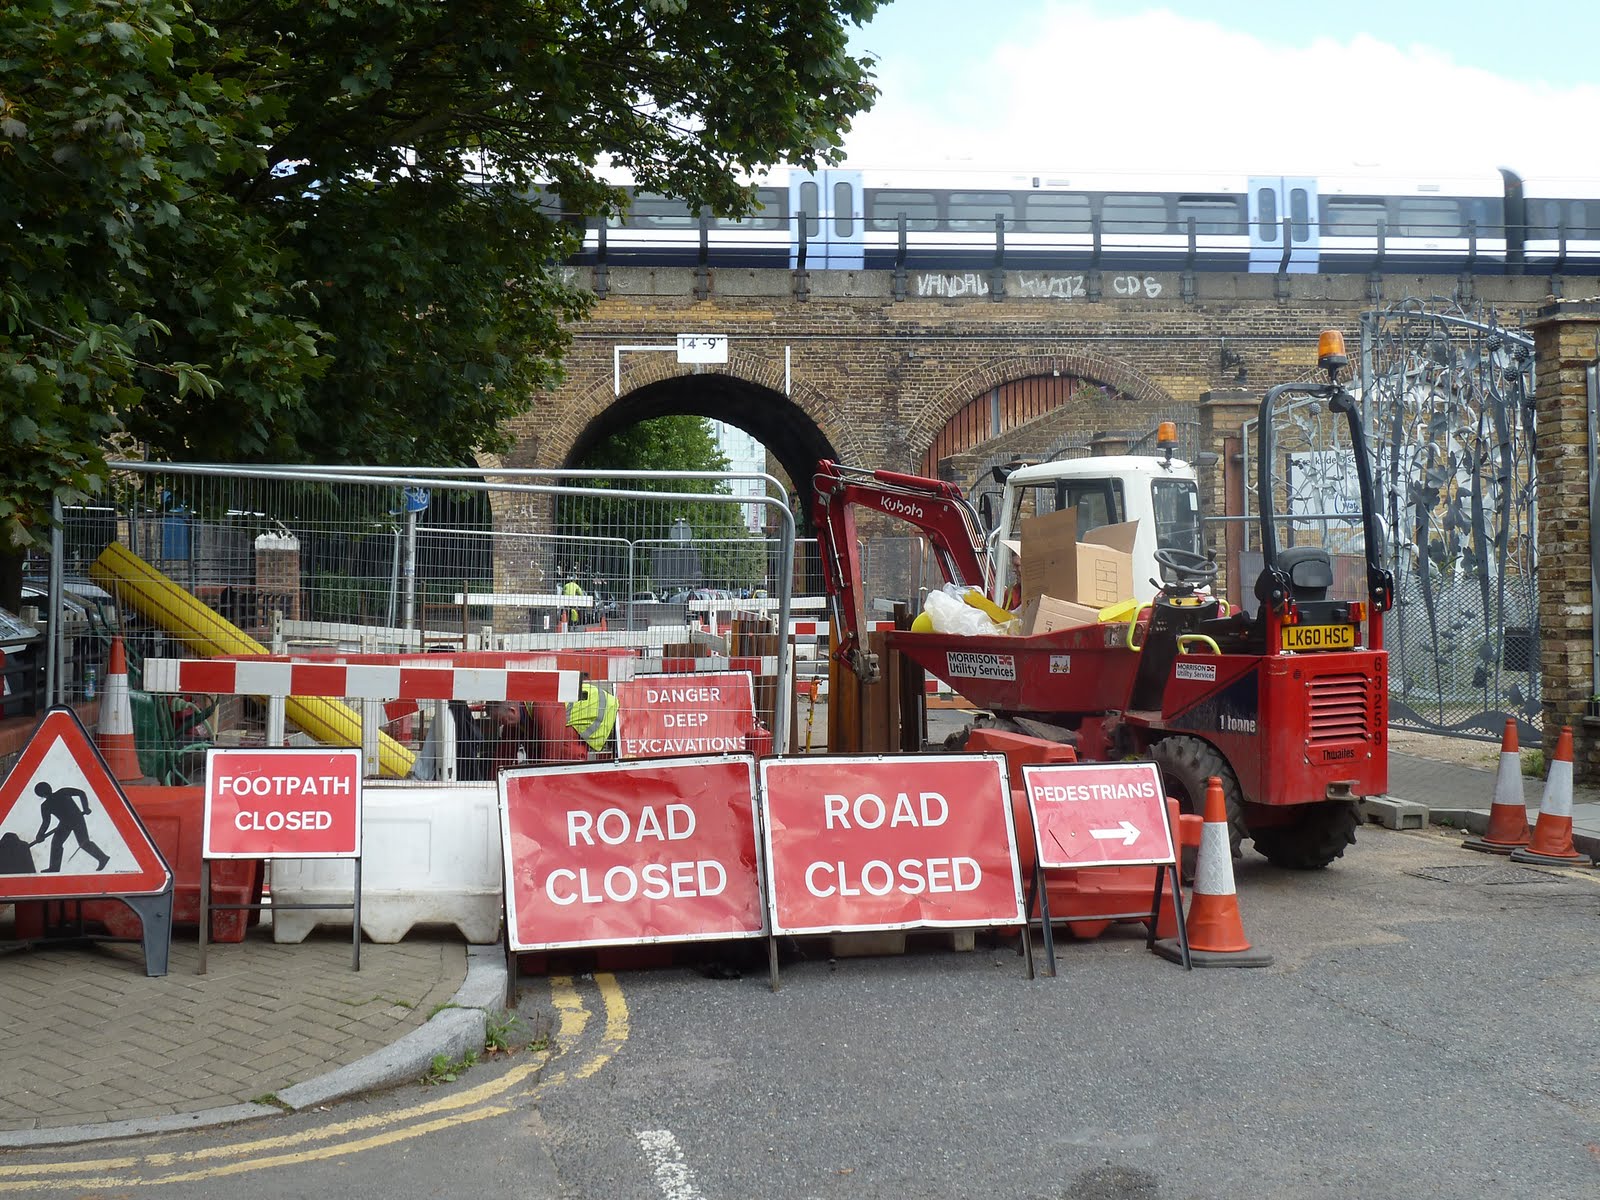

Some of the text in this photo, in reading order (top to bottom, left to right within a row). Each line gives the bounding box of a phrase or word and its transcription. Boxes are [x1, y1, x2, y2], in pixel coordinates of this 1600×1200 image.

[917, 273, 989, 297] VANDAL
[880, 496, 923, 518] Kubota
[1287, 627, 1349, 646] LK60 HSC
[948, 652, 998, 665] MORRISON
[1177, 663, 1206, 671] MORRISON
[949, 663, 1014, 678] Utility Services
[1177, 670, 1215, 679] Utility Services
[646, 687, 721, 704] DANGER
[663, 713, 708, 728] DEEP
[1227, 715, 1256, 733] tonne
[626, 735, 746, 754] EXCAVATIONS
[1323, 749, 1355, 760] Thwaites
[218, 776, 350, 796] FOOTPATH
[1033, 782, 1155, 802] PEDESTRIANS
[824, 792, 949, 830] ROAD
[234, 811, 332, 831] CLOSED
[566, 804, 696, 846] ROAD
[545, 860, 727, 906] CLOSED
[804, 856, 982, 898] CLOSED
